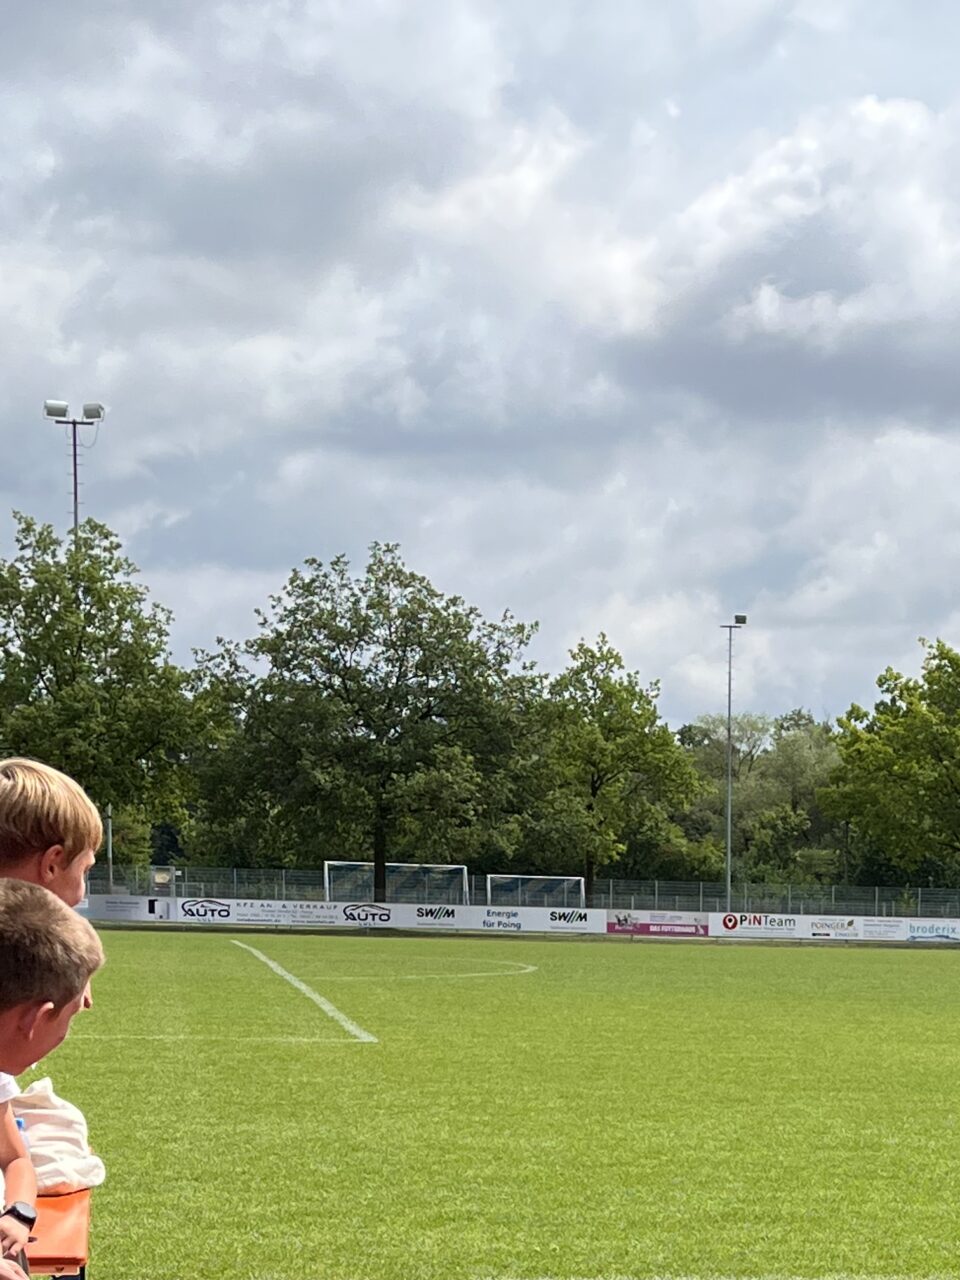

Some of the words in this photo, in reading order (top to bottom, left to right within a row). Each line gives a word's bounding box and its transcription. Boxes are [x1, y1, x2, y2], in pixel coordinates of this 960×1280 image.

[183, 908, 231, 918] AUTO
[345, 912, 391, 922] AUTO
[486, 910, 519, 919] Energie
[497, 921, 522, 930] Poing
